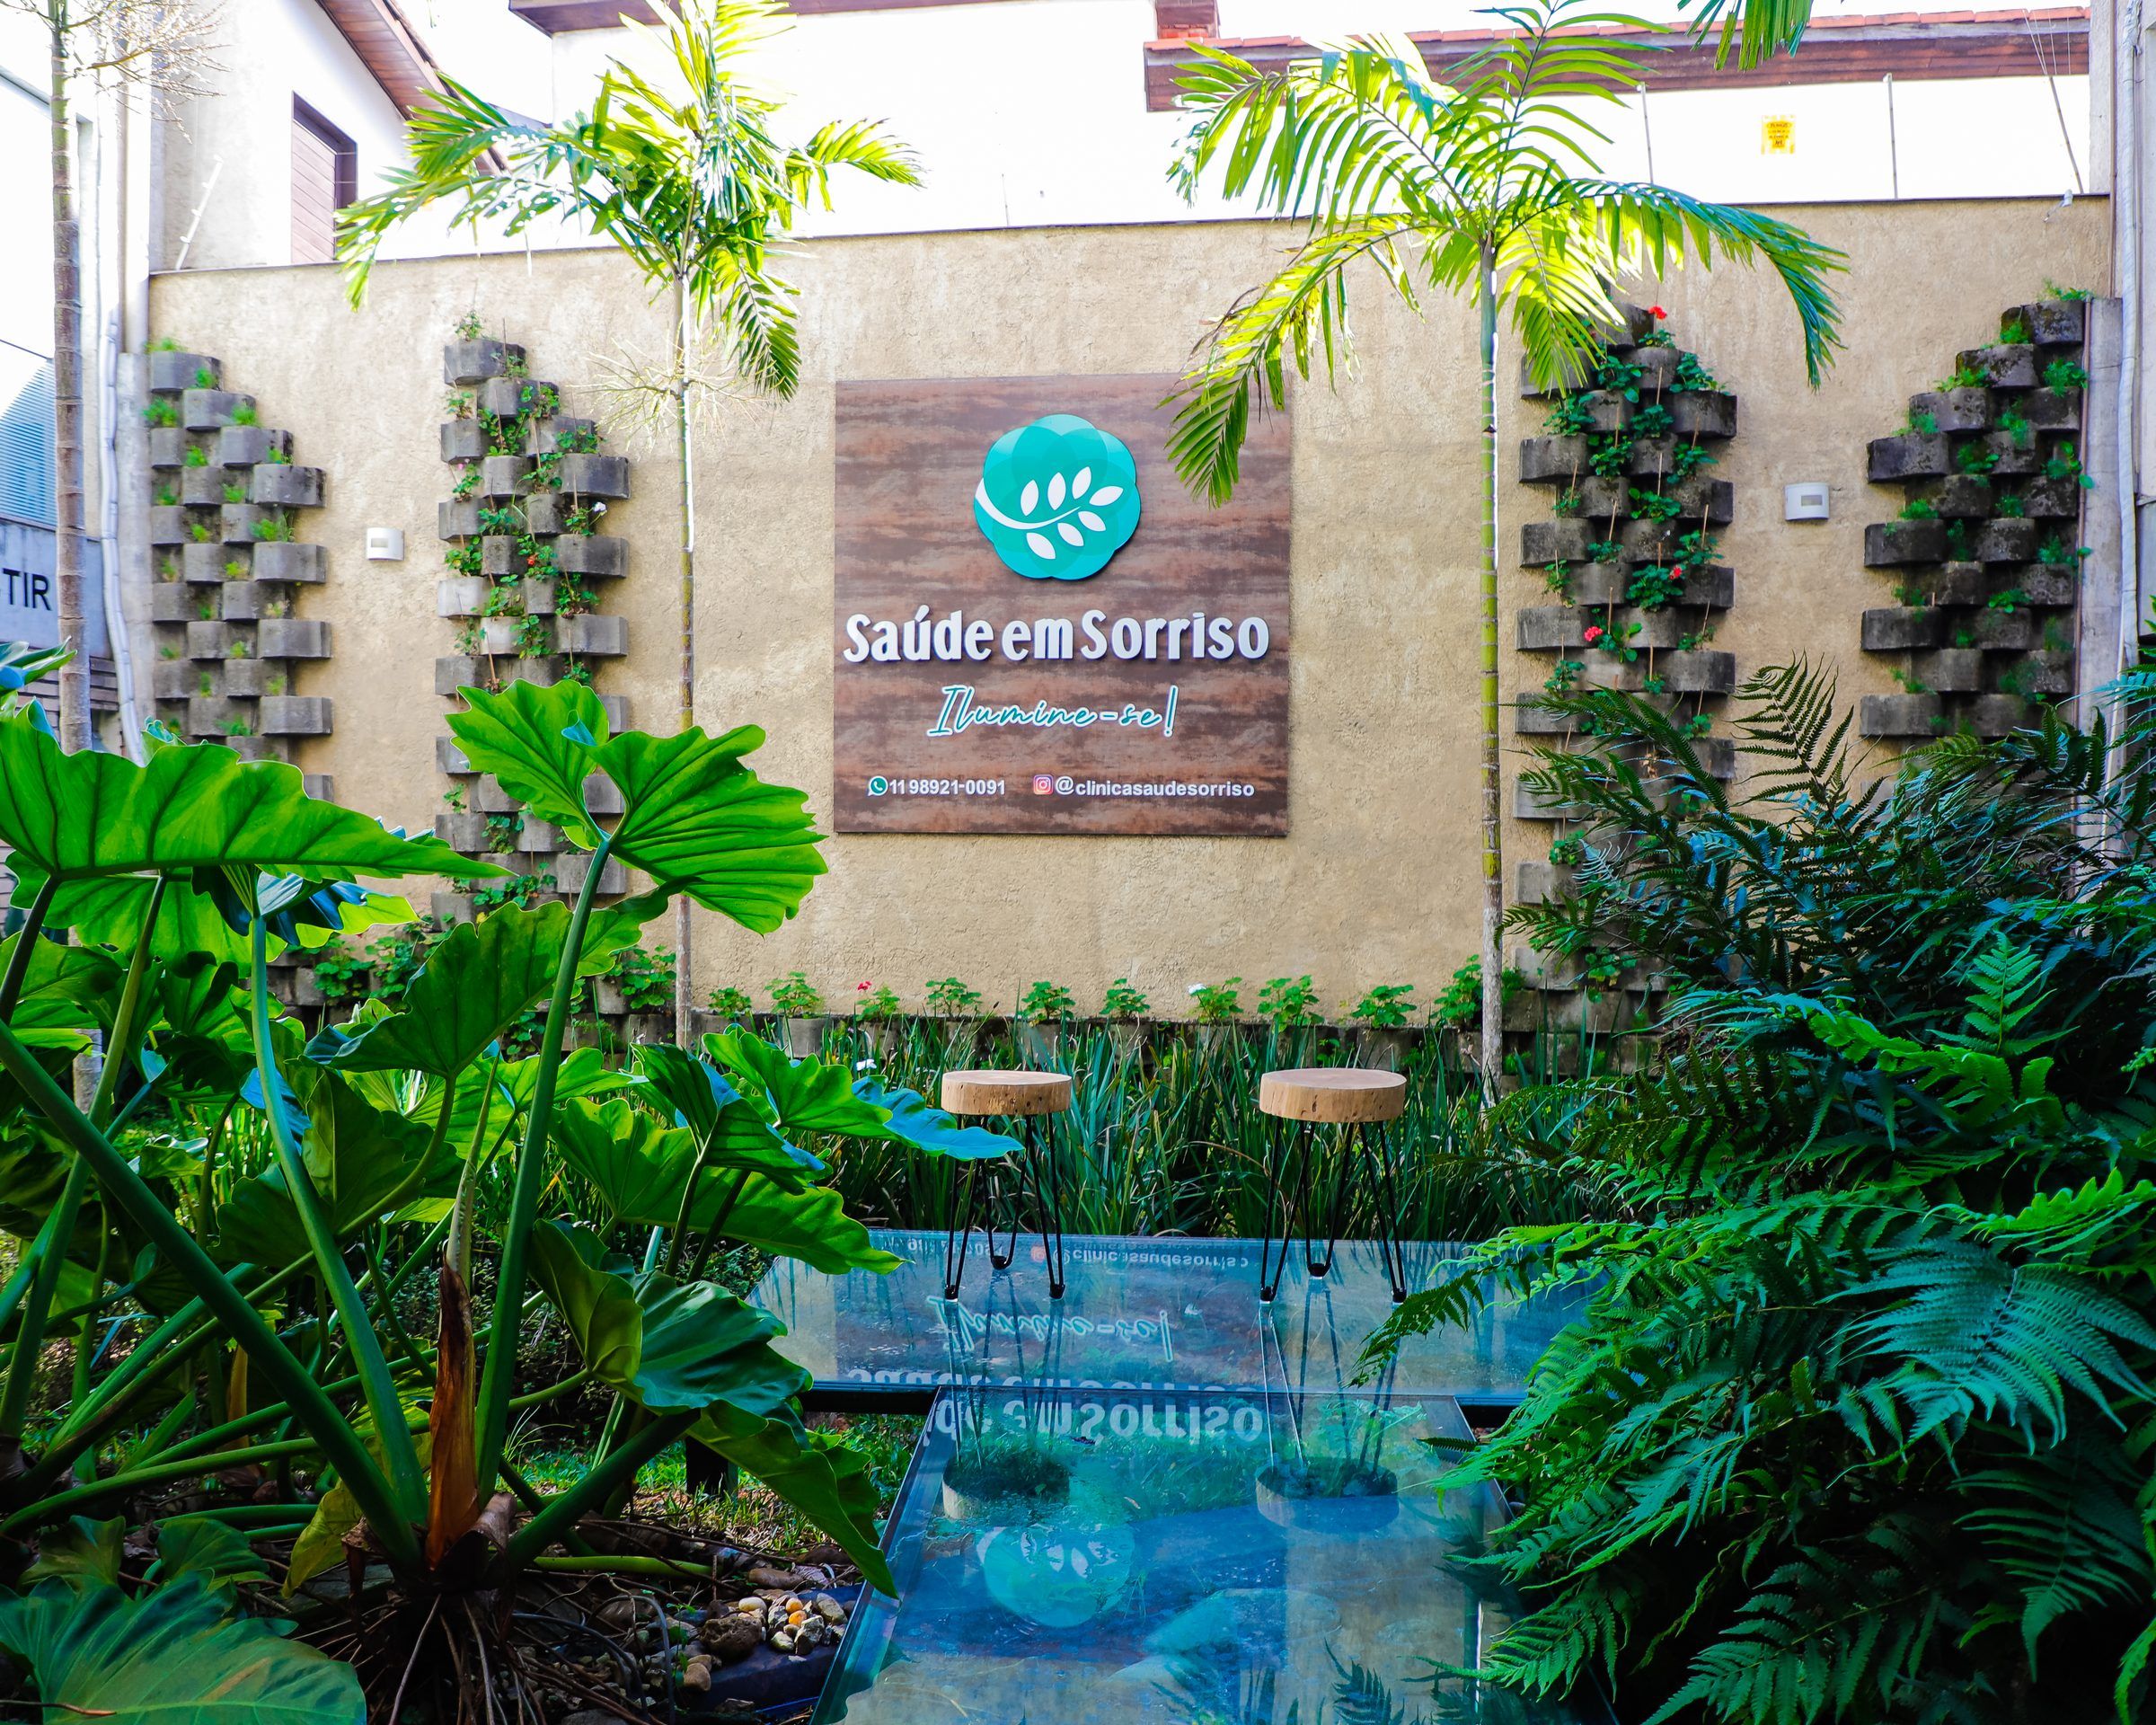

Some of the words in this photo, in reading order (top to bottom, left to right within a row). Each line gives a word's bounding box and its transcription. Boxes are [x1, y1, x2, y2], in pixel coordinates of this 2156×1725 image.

[843, 605, 994, 663] Saúde
[1002, 616, 1074, 661] em
[1082, 609, 1269, 661] Sorriso
[926, 685, 1180, 737] Ilumine-se!
[909, 779, 1006, 795] 98921-0091
[1055, 775, 1255, 798] @clinicasaudesorriso
